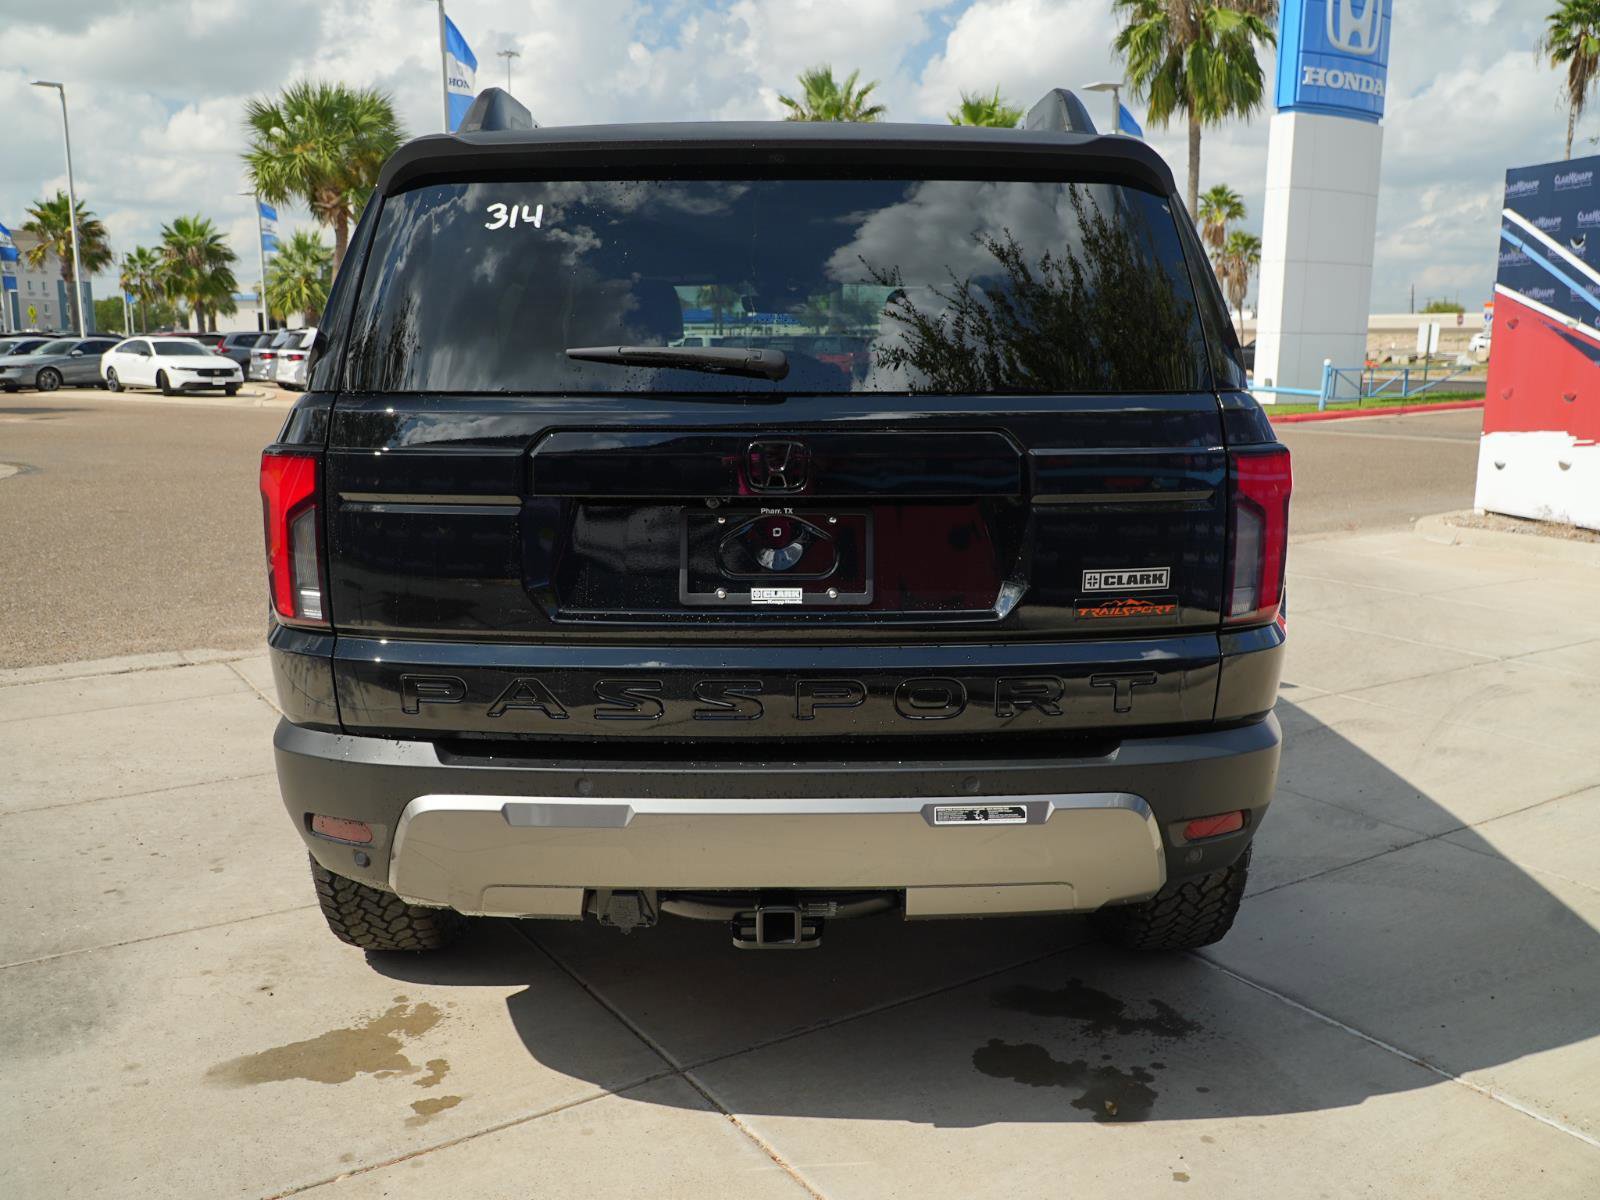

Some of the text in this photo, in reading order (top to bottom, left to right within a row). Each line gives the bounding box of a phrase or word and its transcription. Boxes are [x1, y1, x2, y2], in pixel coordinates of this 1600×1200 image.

[1302, 66, 1385, 97] HONDA
[484, 202, 544, 230] 314
[1103, 572, 1165, 587] CLARK
[1077, 604, 1177, 617] TRAILSPORT
[401, 672, 1158, 720] PASSPORT
